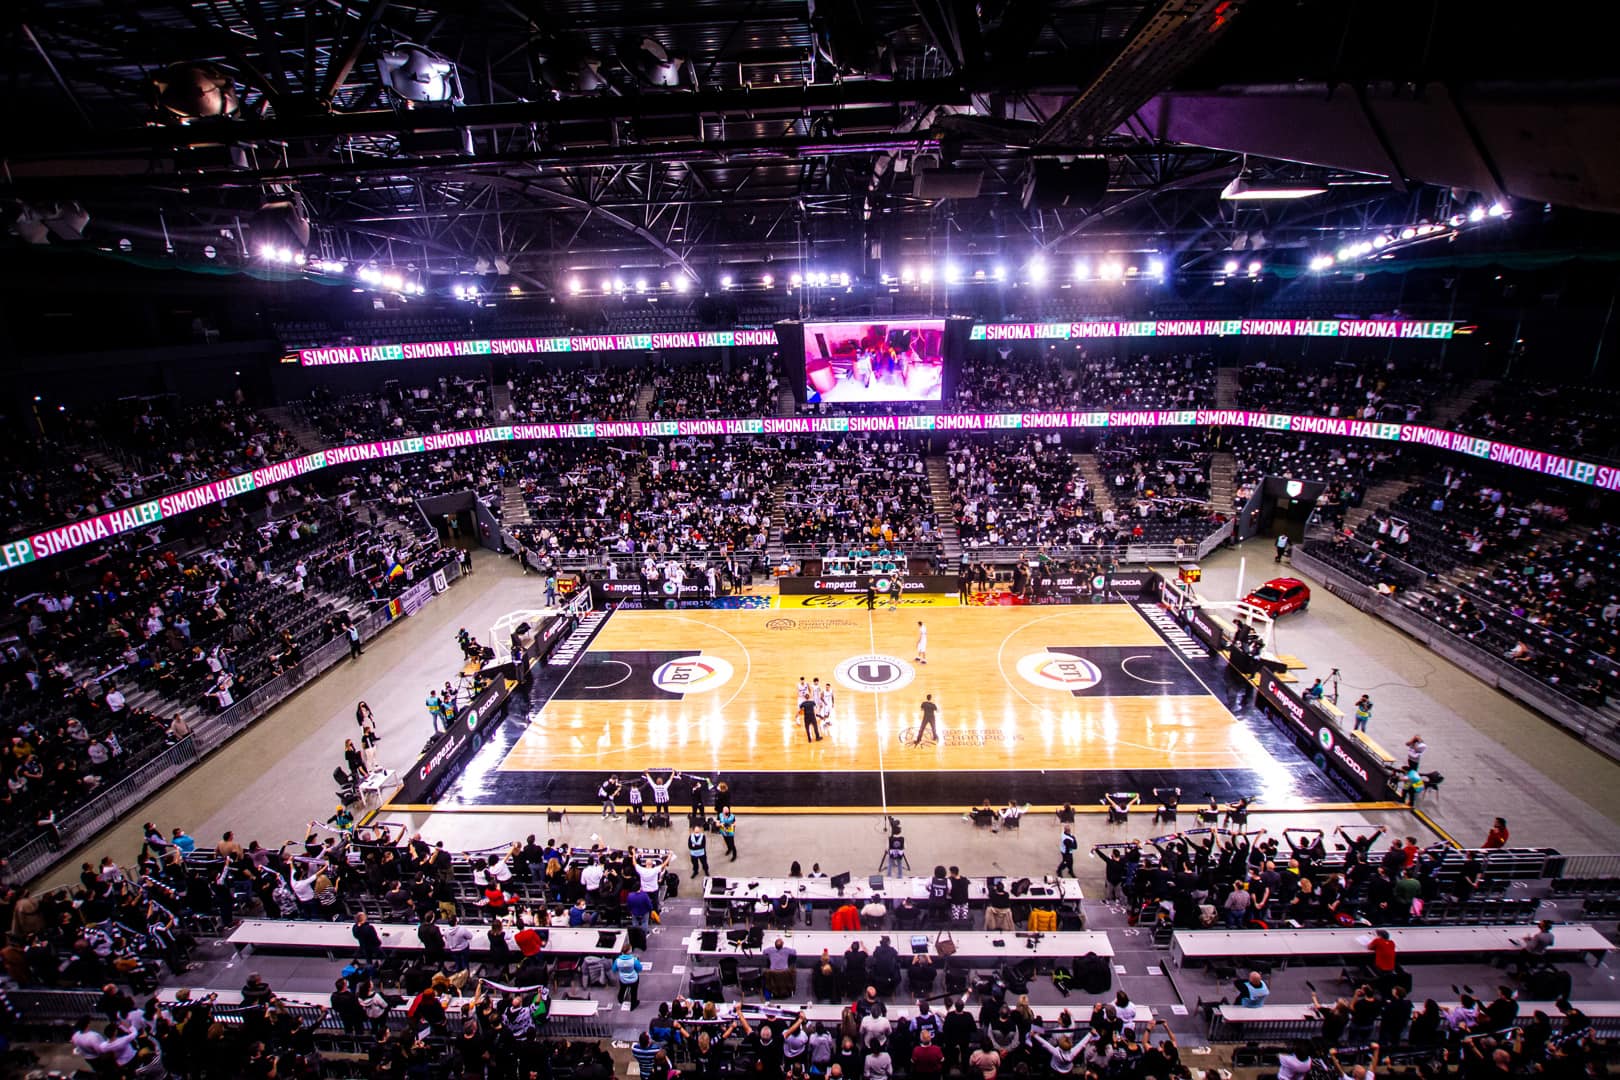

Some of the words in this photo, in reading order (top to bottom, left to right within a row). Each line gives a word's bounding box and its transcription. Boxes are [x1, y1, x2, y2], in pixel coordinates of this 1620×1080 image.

[987, 326, 1031, 339] SIMONA
[1034, 324, 1070, 338] HALEP
[1072, 324, 1116, 338] SIMONA
[1119, 323, 1155, 336] HALEP
[1157, 321, 1201, 335] SIMONA
[1204, 321, 1241, 335] HALEP
[1242, 321, 1291, 335] SIMONA
[1294, 321, 1338, 336] HALEP
[1340, 322, 1396, 337] SIMONA
[1401, 322, 1451, 338] HALEP
[303, 349, 359, 366] SIMONA
[361, 346, 401, 361] HALEP
[404, 343, 452, 358] SIMONA
[454, 341, 490, 355] HALEP
[492, 339, 534, 354] SIMONA
[536, 338, 569, 352] HALEP
[572, 336, 614, 351] SIMONA
[617, 335, 650, 349] HALEP
[653, 333, 696, 348] SIMONA
[698, 332, 733, 347] HALEP
[735, 331, 778, 345] SIMONA
[33, 521, 108, 558] SIMONA
[110, 505, 159, 534] HALEP
[161, 487, 216, 518] SIMONA
[216, 472, 253, 500] HALEP
[254, 462, 295, 488] SIMONA
[297, 453, 325, 474] HALEP
[327, 443, 379, 465] SIMONA
[382, 438, 423, 456] HALEP
[425, 431, 473, 450] SIMONA
[476, 427, 512, 443] HALEP
[513, 424, 556, 440] SIMONA
[559, 423, 594, 438] HALEP
[596, 422, 640, 437] SIMONA
[642, 421, 678, 436] HALEP
[680, 420, 724, 435] SIMONA
[727, 419, 762, 434] HALEP
[764, 418, 809, 433] SIMONA
[812, 417, 848, 432] HALEP
[850, 416, 895, 431] SIMONA
[898, 416, 934, 430] HALEP
[937, 415, 981, 429] SIMONA
[984, 414, 1021, 429] HALEP
[1023, 414, 1068, 428] SIMONA
[1071, 413, 1108, 427] HALEP
[1110, 412, 1155, 426] SIMONA
[1158, 411, 1195, 426] HALEP
[1197, 411, 1245, 425] SIMONA
[1247, 413, 1290, 430] HALEP
[1291, 416, 1346, 435] SIMONA
[1349, 421, 1399, 440] HALEP
[1401, 425, 1450, 448] SIMONA
[1451, 434, 1490, 457] HALEP
[1490, 443, 1541, 472] SIMONA
[1544, 455, 1595, 483] HALEP
[858, 665, 891, 683] U
[1268, 681, 1304, 719] Compexit
[420, 736, 454, 780] Compexit
